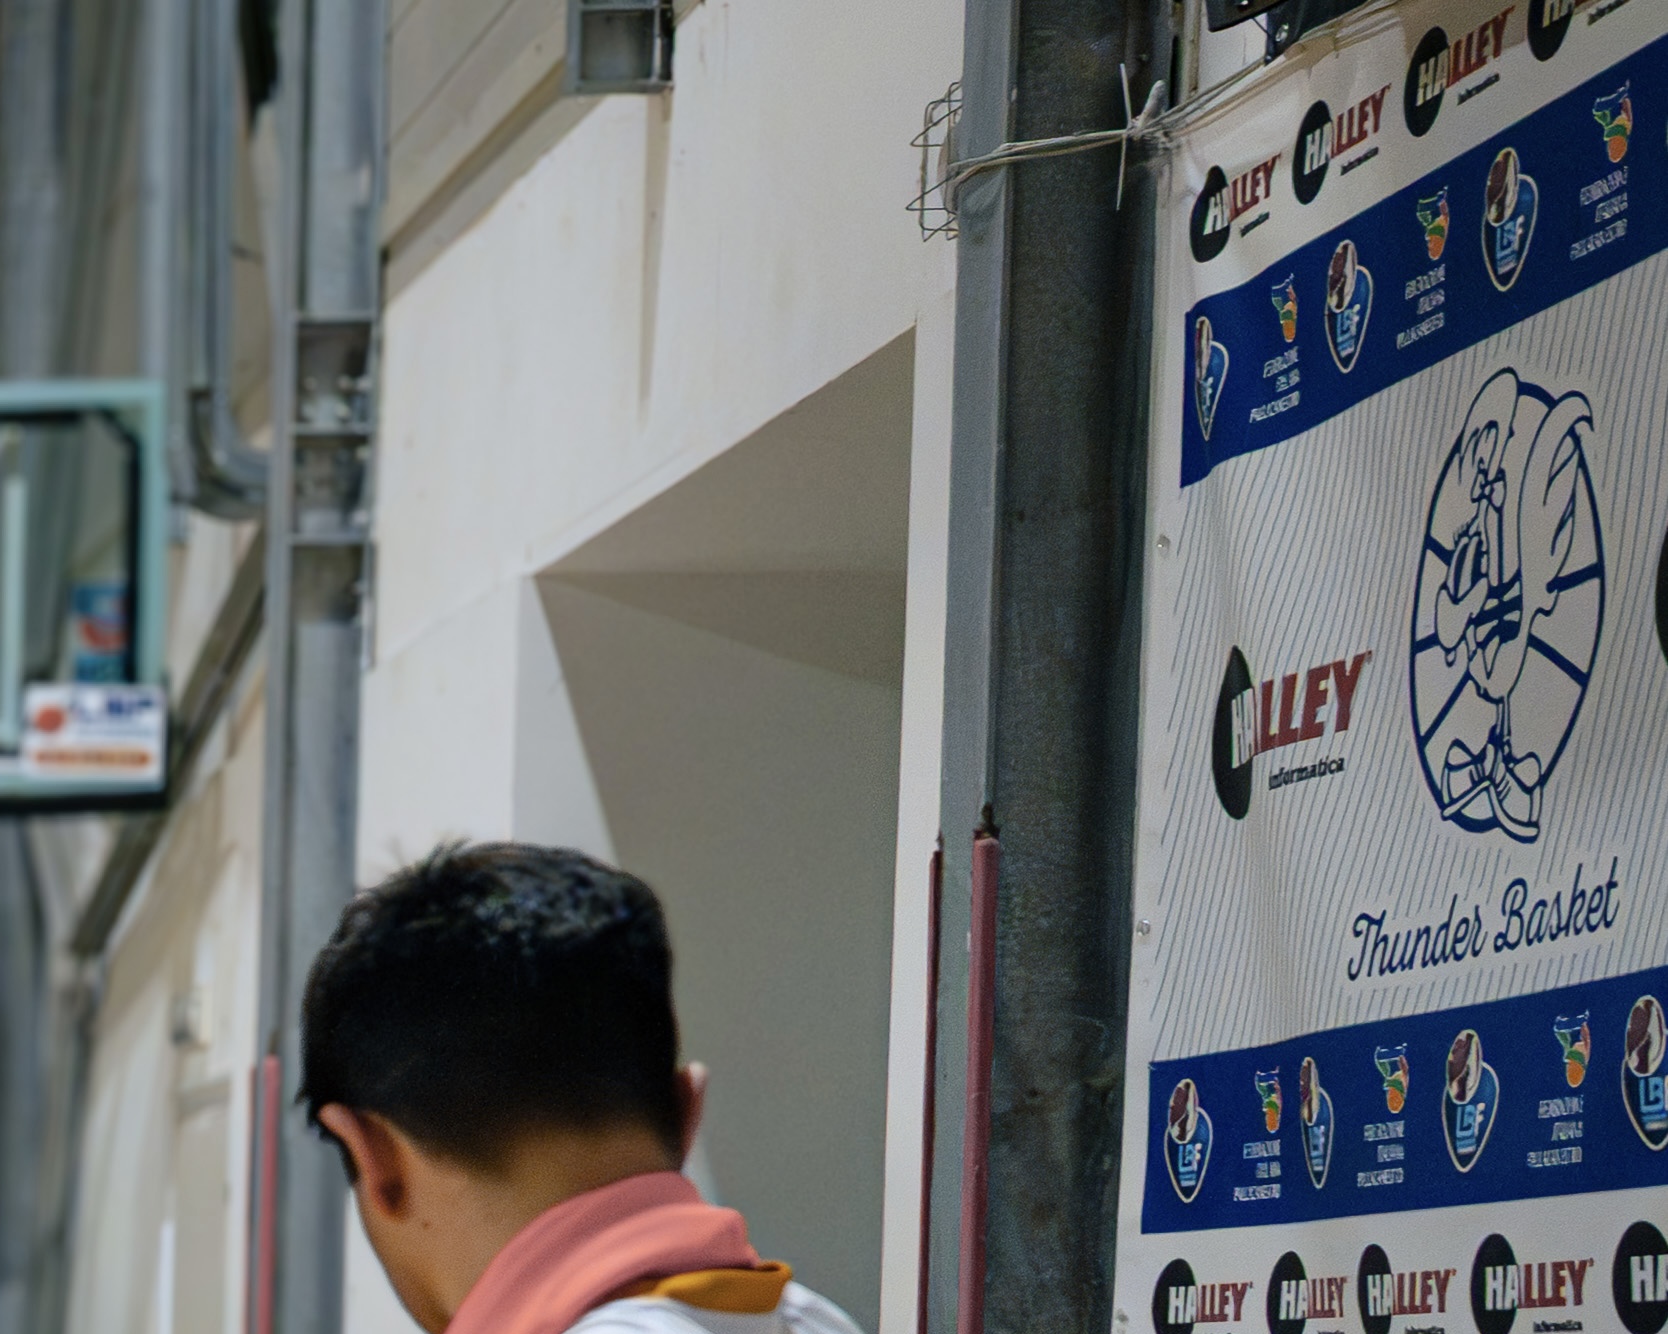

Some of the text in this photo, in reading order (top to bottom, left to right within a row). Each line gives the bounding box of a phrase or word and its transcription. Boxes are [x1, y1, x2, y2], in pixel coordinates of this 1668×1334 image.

[1416, 8, 1515, 107] HALLEY
[1304, 86, 1389, 176] HALLEY
[1203, 155, 1278, 236] HALLEY
[1231, 652, 1368, 770] HALLEY
[1268, 756, 1346, 791] informatica
[1347, 856, 1620, 982] Thunder Basket
[1168, 1282, 1248, 1325] HALLEY
[1279, 1277, 1346, 1321] HALLEY
[1367, 1269, 1452, 1317] HALLEY
[1485, 1259, 1589, 1311] HALLEY
